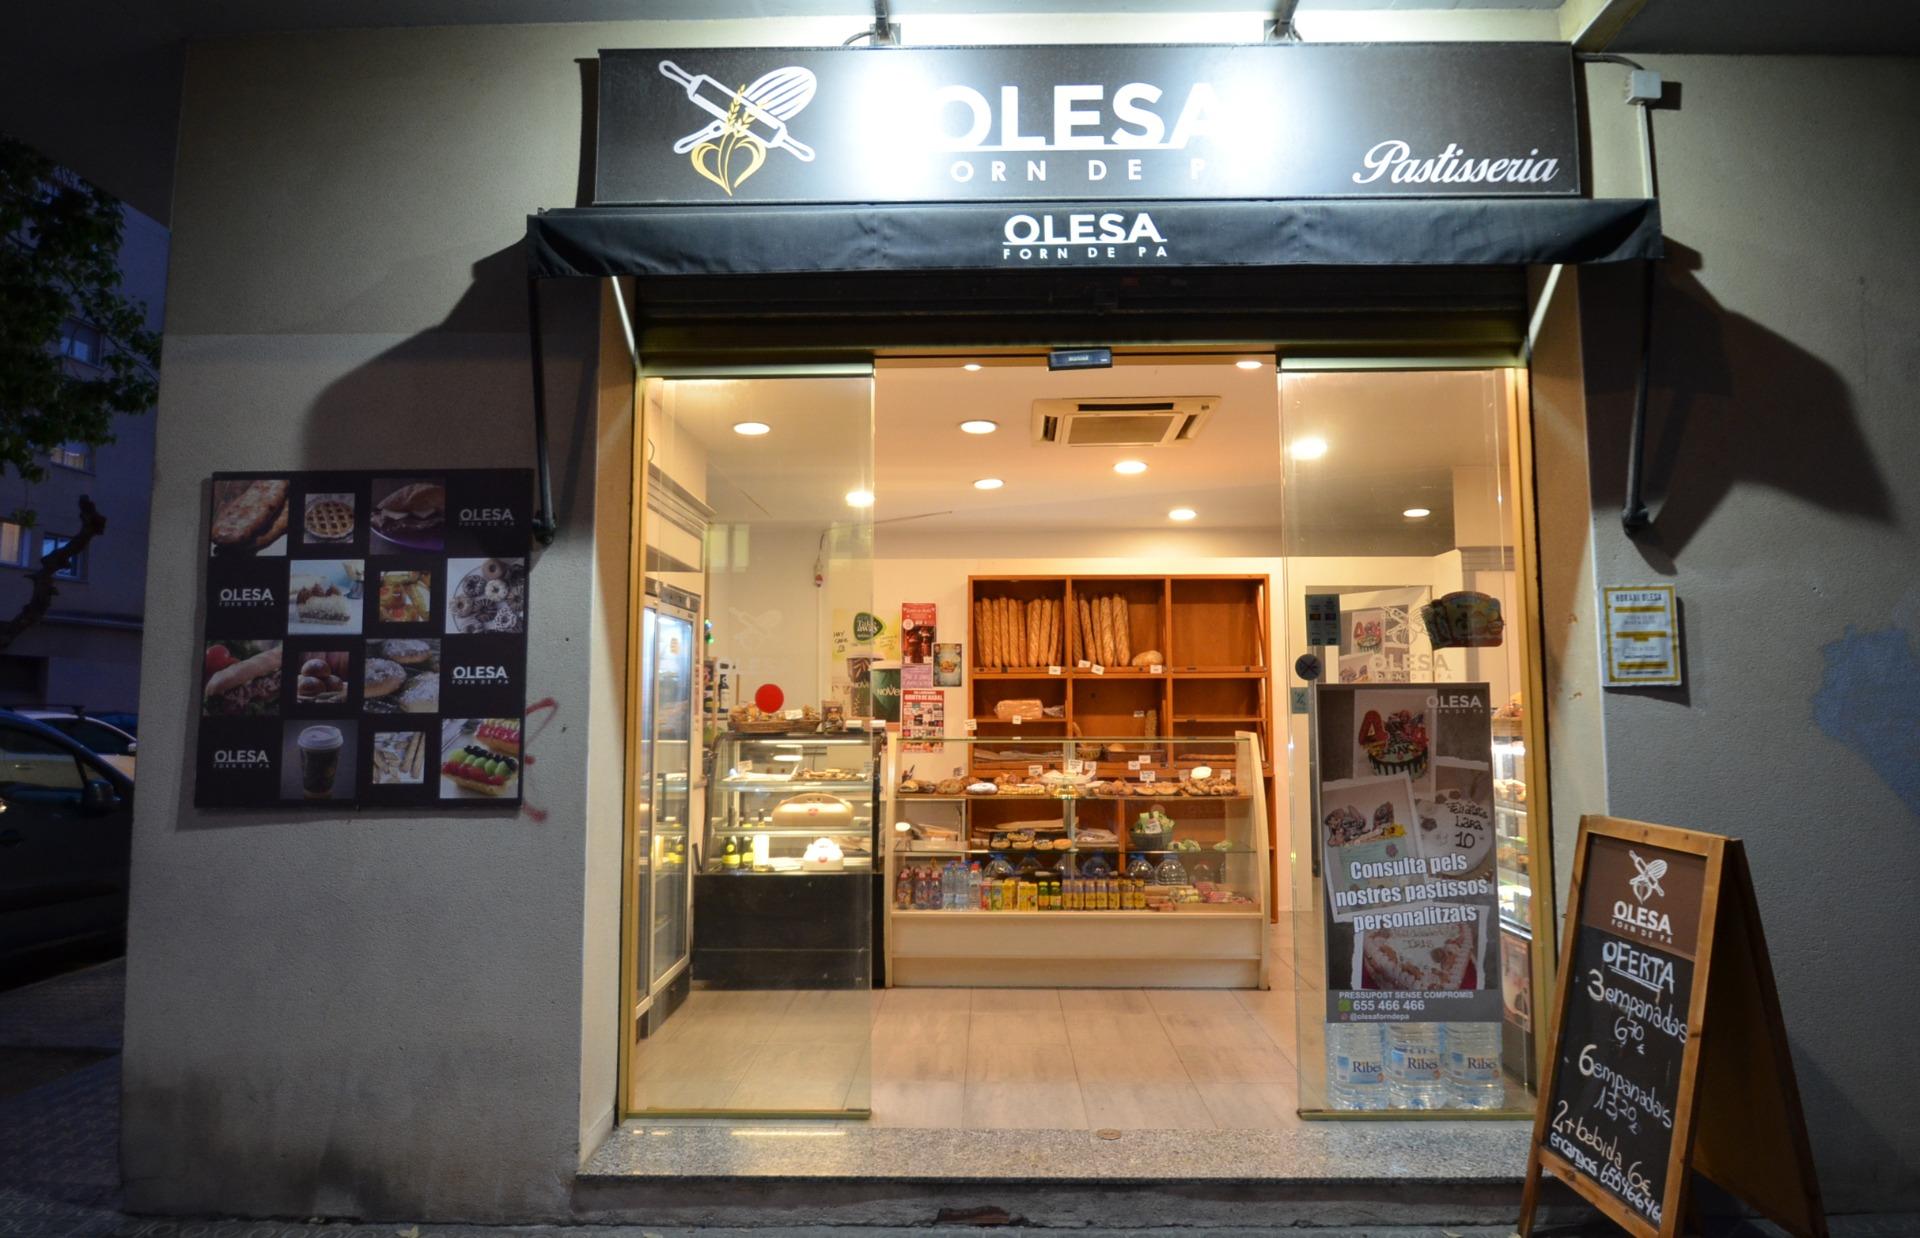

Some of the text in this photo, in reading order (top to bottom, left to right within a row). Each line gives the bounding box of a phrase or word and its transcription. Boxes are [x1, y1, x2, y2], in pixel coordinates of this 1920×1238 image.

[933, 82, 1238, 150] OLESA
[934, 160, 1048, 183] ORN
[1088, 159, 1143, 181] DE
[1352, 140, 1560, 184] Pastisseria
[1003, 212, 1168, 245] OLESA
[1003, 246, 1168, 260] FORN DE PA
[460, 508, 513, 521] OLESA
[220, 588, 274, 600] OLESA
[453, 666, 508, 678] OLESA
[1426, 695, 1482, 708] OLESA
[214, 750, 269, 763] OLESA
[1454, 831, 1476, 849] 10
[1350, 853, 1468, 880] Consulta pels
[1335, 878, 1489, 907] nostres pastissos
[1353, 905, 1478, 933] personalitzats
[1612, 901, 1673, 935] OLESA
[1602, 941, 1675, 994] OFERTA
[1338, 991, 1392, 999] PRESSUPOST
[1394, 991, 1422, 999] SENSE
[1353, 1000, 1425, 1011] 655 466 466
[1352, 1060, 1382, 1073] Ribes
[1407, 1056, 1438, 1070] Ribes
[1550, 1132, 1598, 1177] encargos
